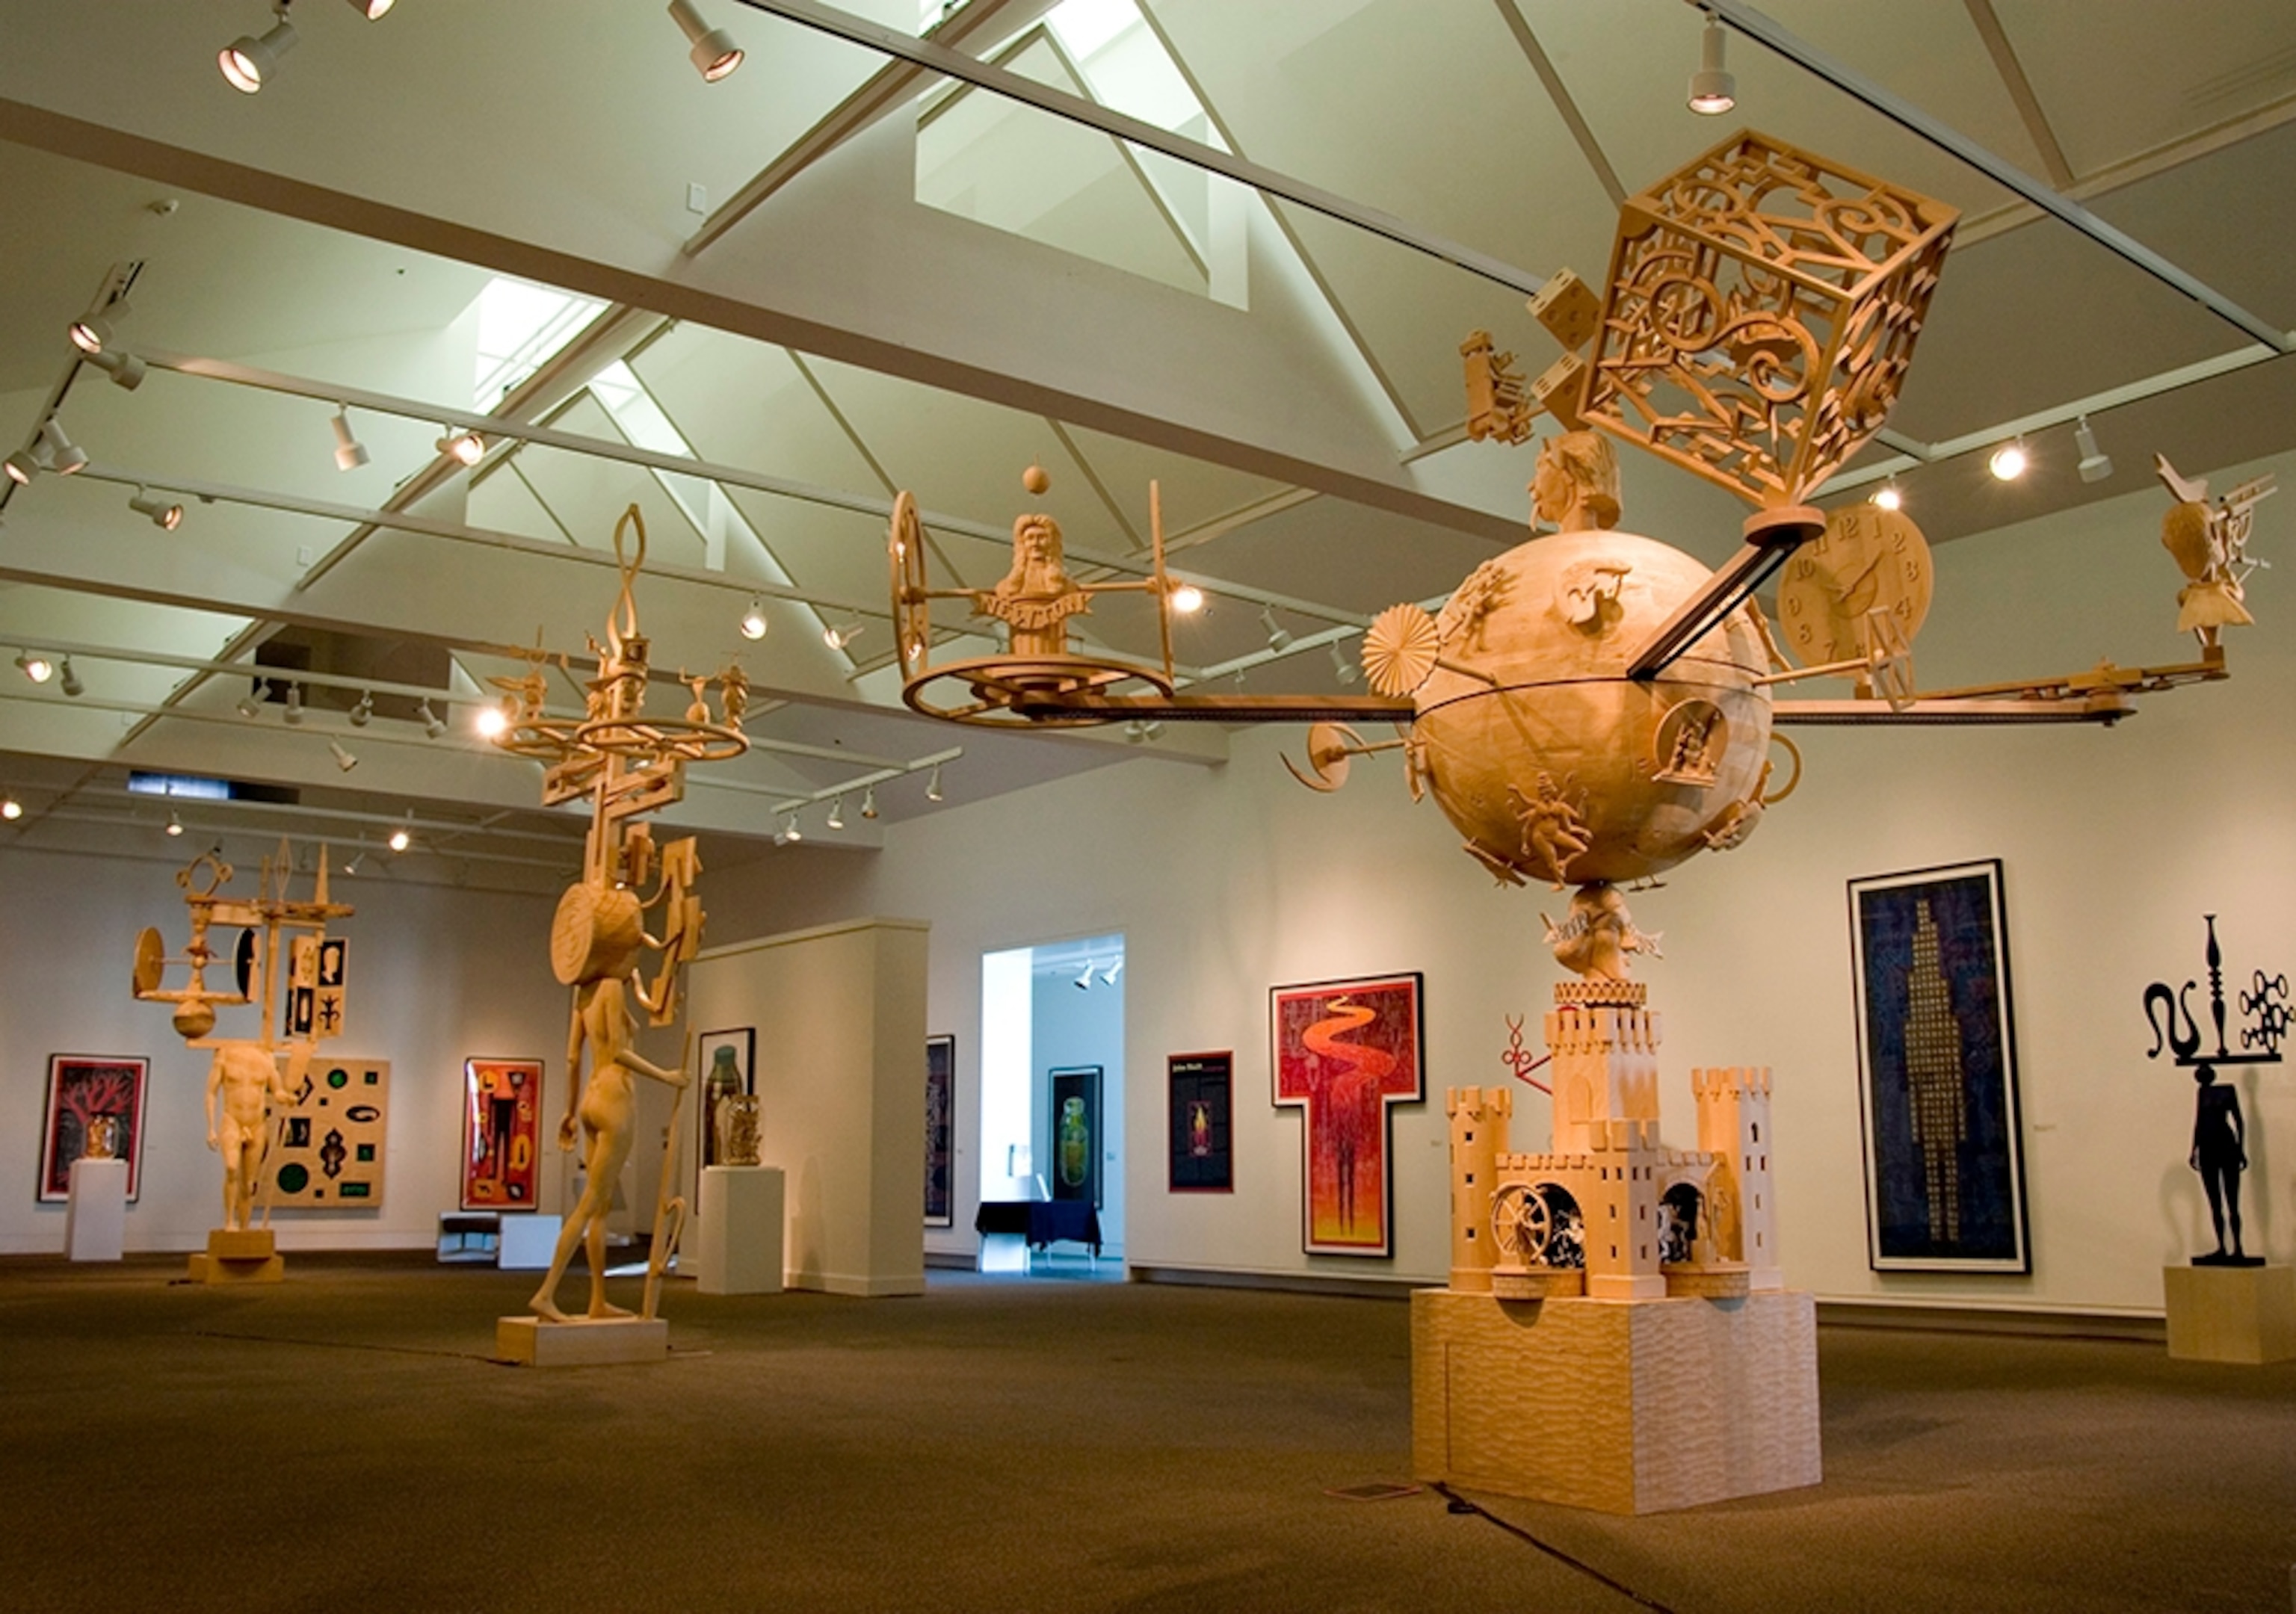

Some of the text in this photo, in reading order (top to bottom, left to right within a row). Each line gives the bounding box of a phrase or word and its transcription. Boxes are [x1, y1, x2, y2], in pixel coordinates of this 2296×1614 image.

[1838, 516, 1859, 541] 12
[1874, 516, 1883, 539] 1
[1813, 536, 1829, 557] 11
[1892, 533, 1907, 554] 2
[1796, 559, 1815, 582] 10
[1906, 560, 1919, 582] 3
[1787, 596, 1802, 616] 9
[1895, 598, 1913, 620] 4
[1799, 623, 1812, 645] 8
[1823, 640, 1838, 663] 7
